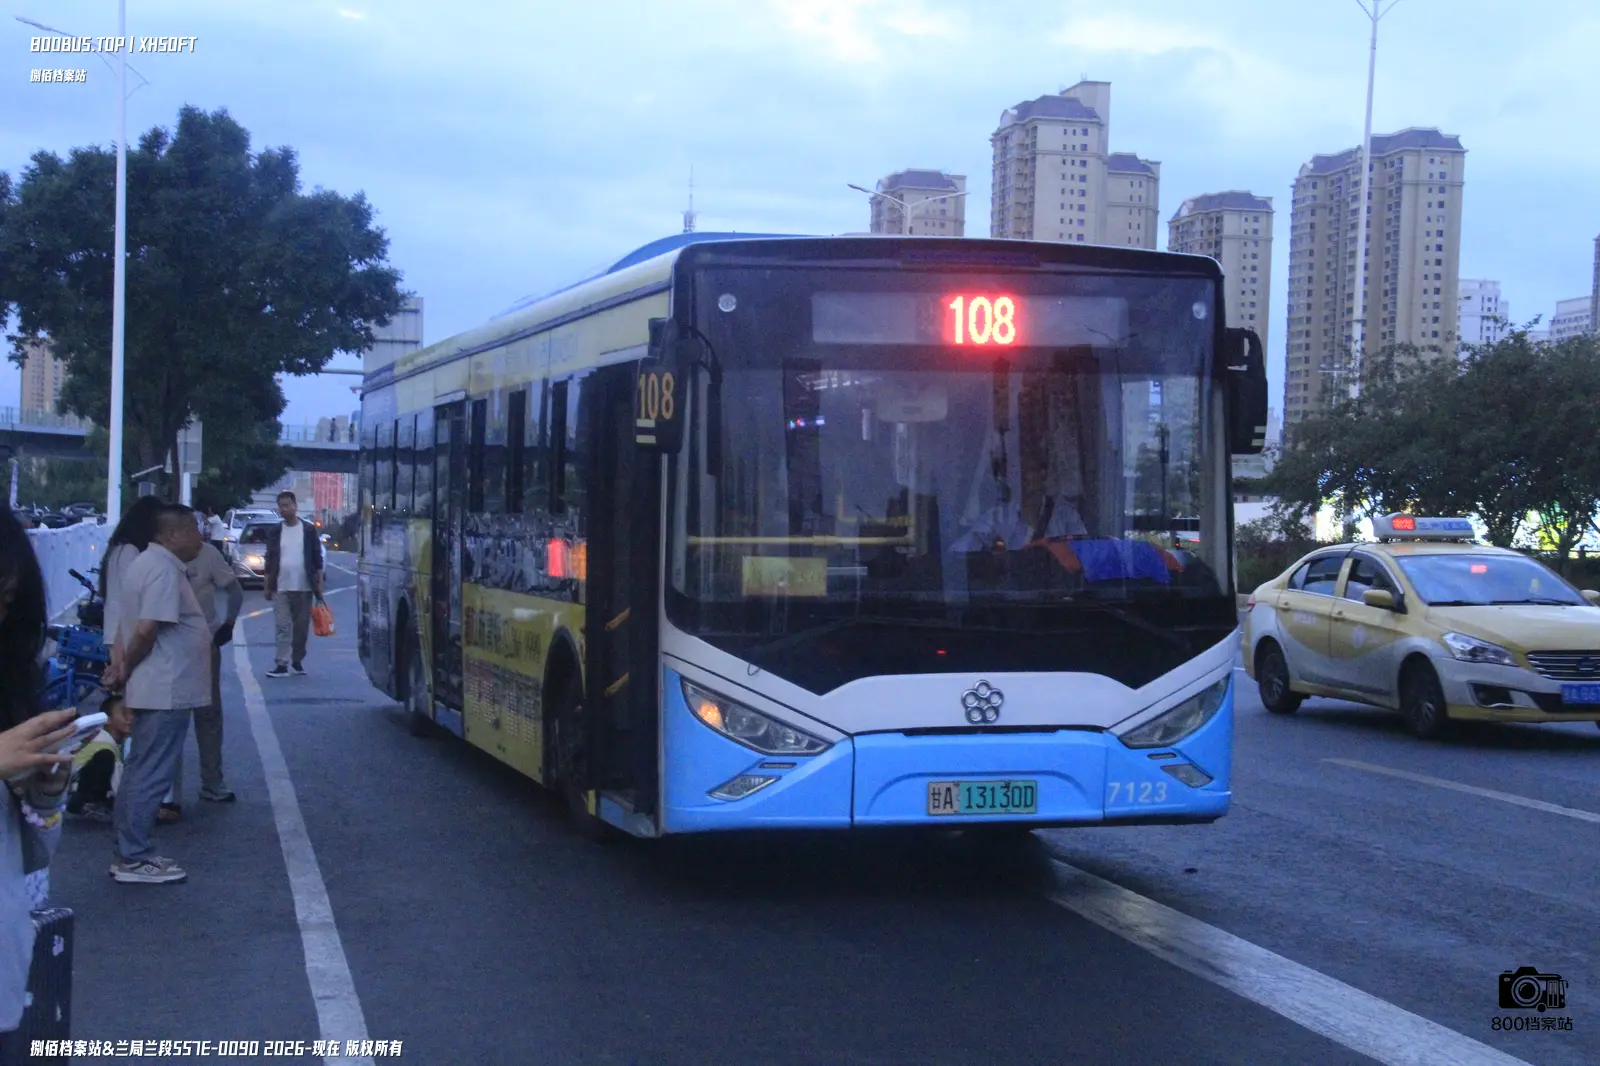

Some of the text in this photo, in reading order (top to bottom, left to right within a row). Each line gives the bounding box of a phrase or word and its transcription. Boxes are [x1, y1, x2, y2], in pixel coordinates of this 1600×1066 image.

[950, 295, 1016, 345] 108
[638, 372, 674, 420] 108
[1107, 781, 1168, 803] 7123
